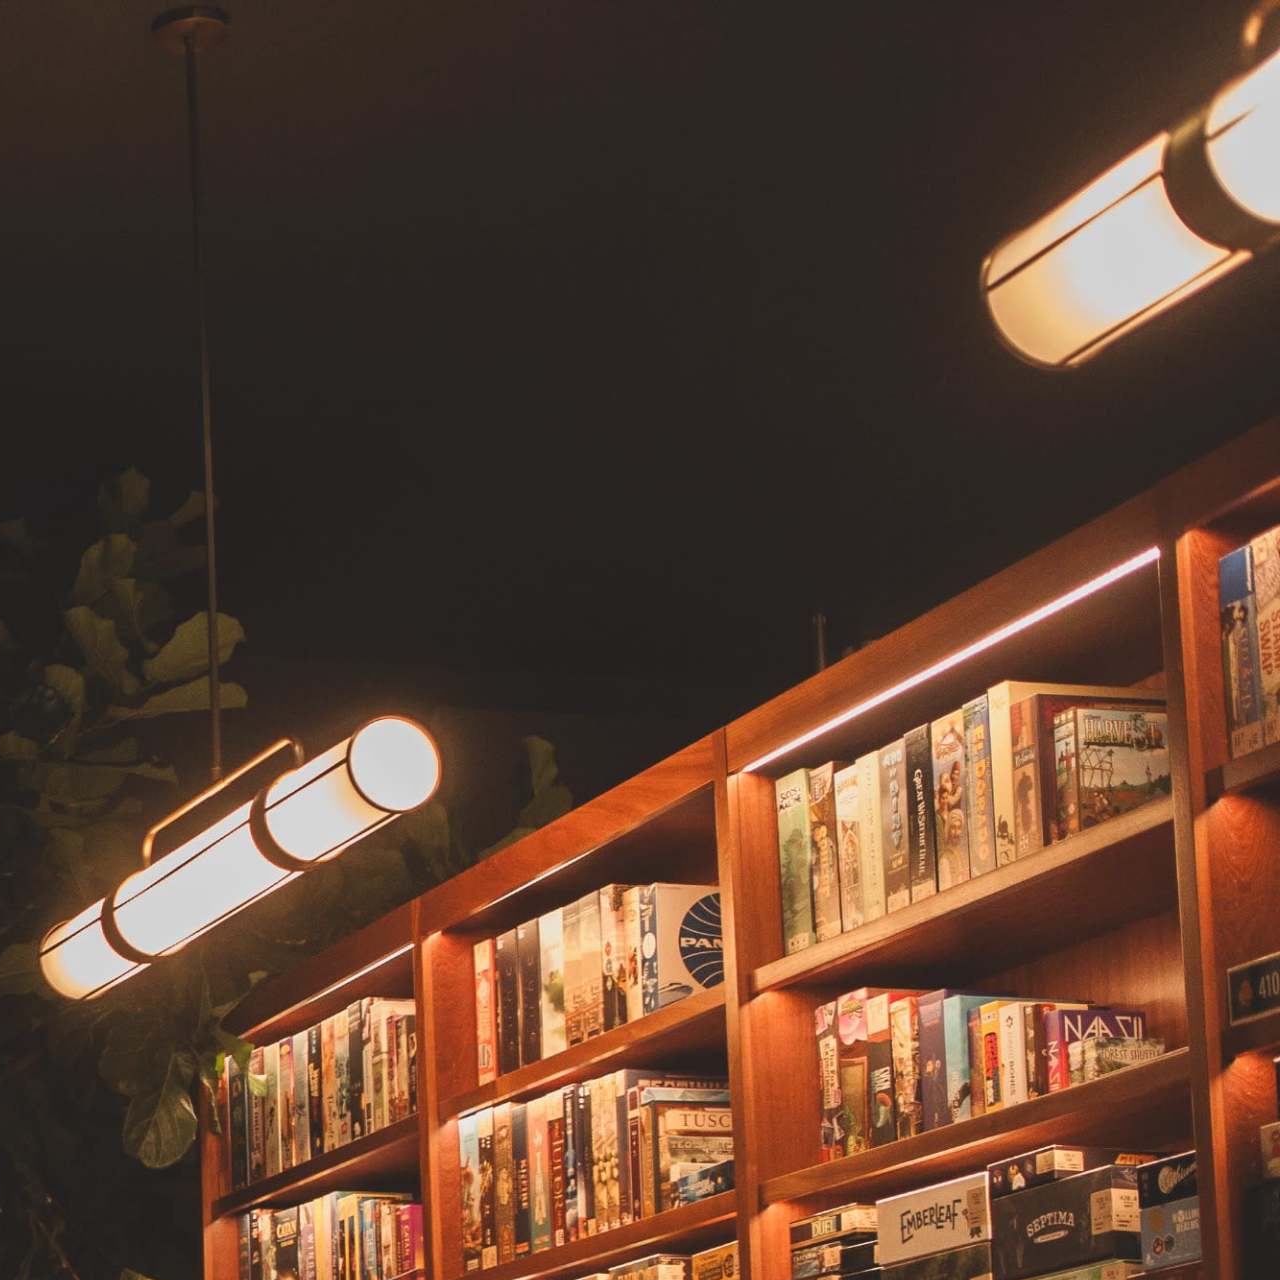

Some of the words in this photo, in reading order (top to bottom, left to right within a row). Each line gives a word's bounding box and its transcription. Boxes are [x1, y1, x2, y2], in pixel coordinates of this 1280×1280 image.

[1084, 717, 1169, 745] HARVEST
[900, 1199, 962, 1245] EMBERLEAF
[1026, 1210, 1075, 1238] SEPTIMA
